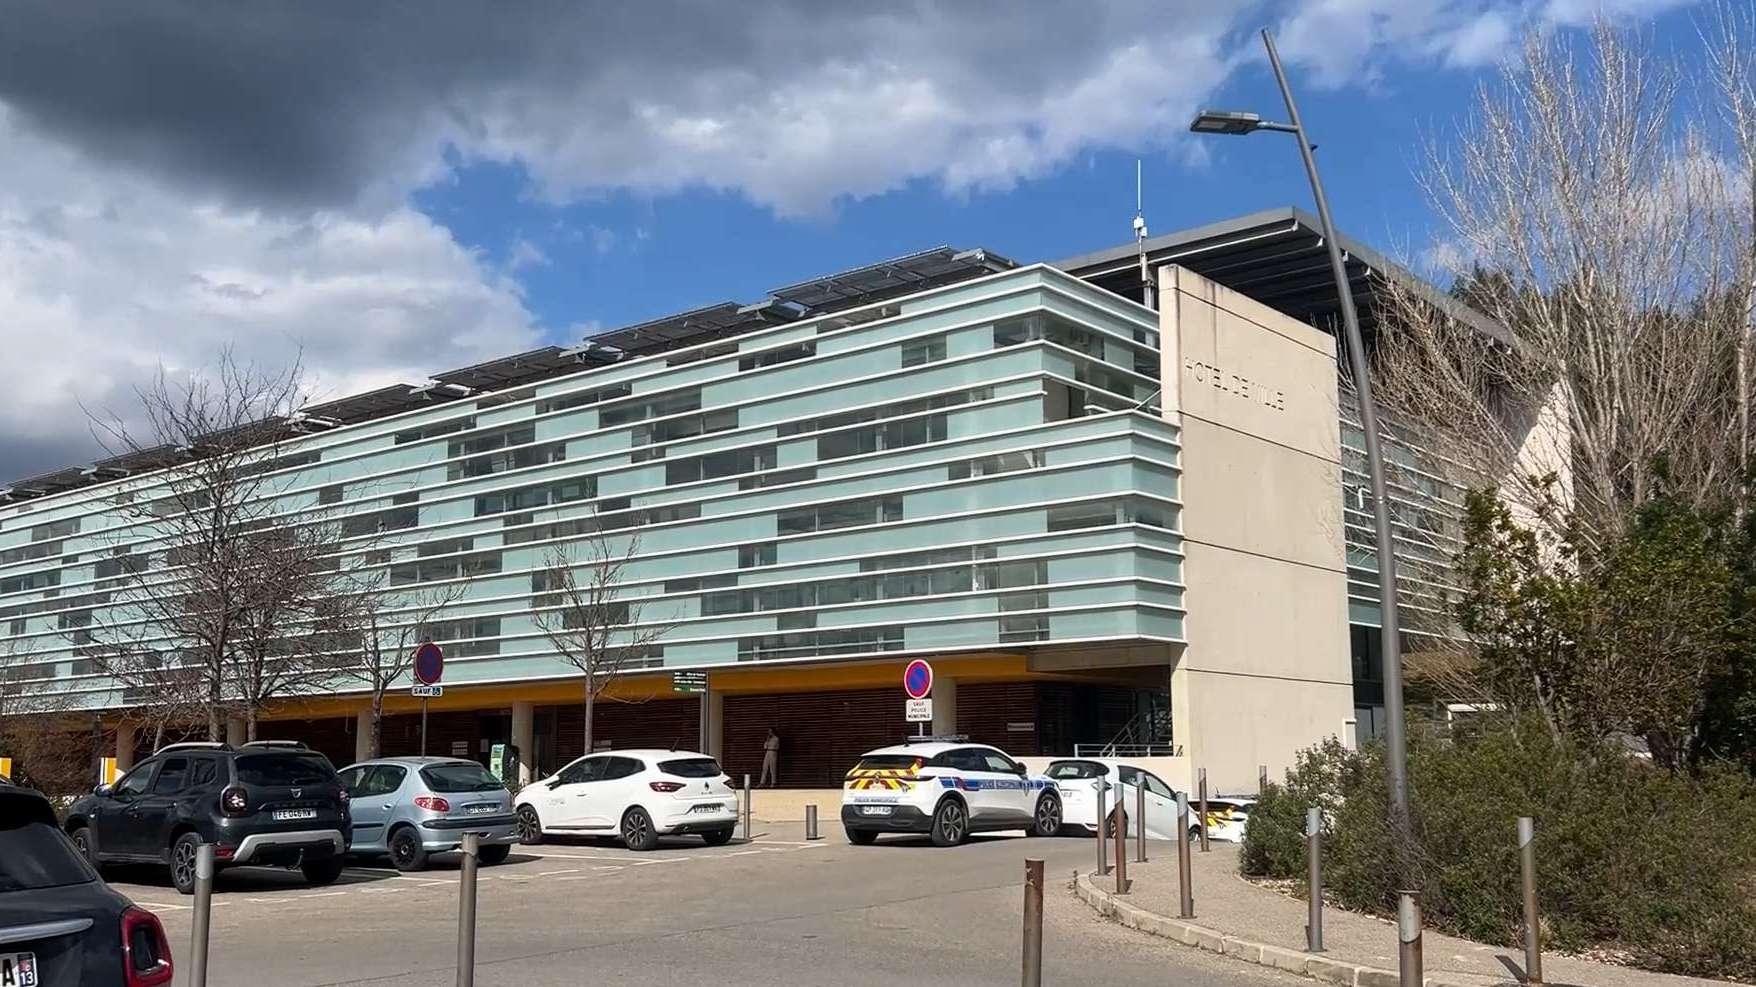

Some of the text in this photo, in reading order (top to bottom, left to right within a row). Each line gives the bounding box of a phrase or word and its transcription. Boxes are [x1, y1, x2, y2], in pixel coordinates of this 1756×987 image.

[1184, 356, 1284, 411] HOTEL DE VILLE
[414, 687, 430, 695] SAUF
[20, 971, 34, 985] 13
